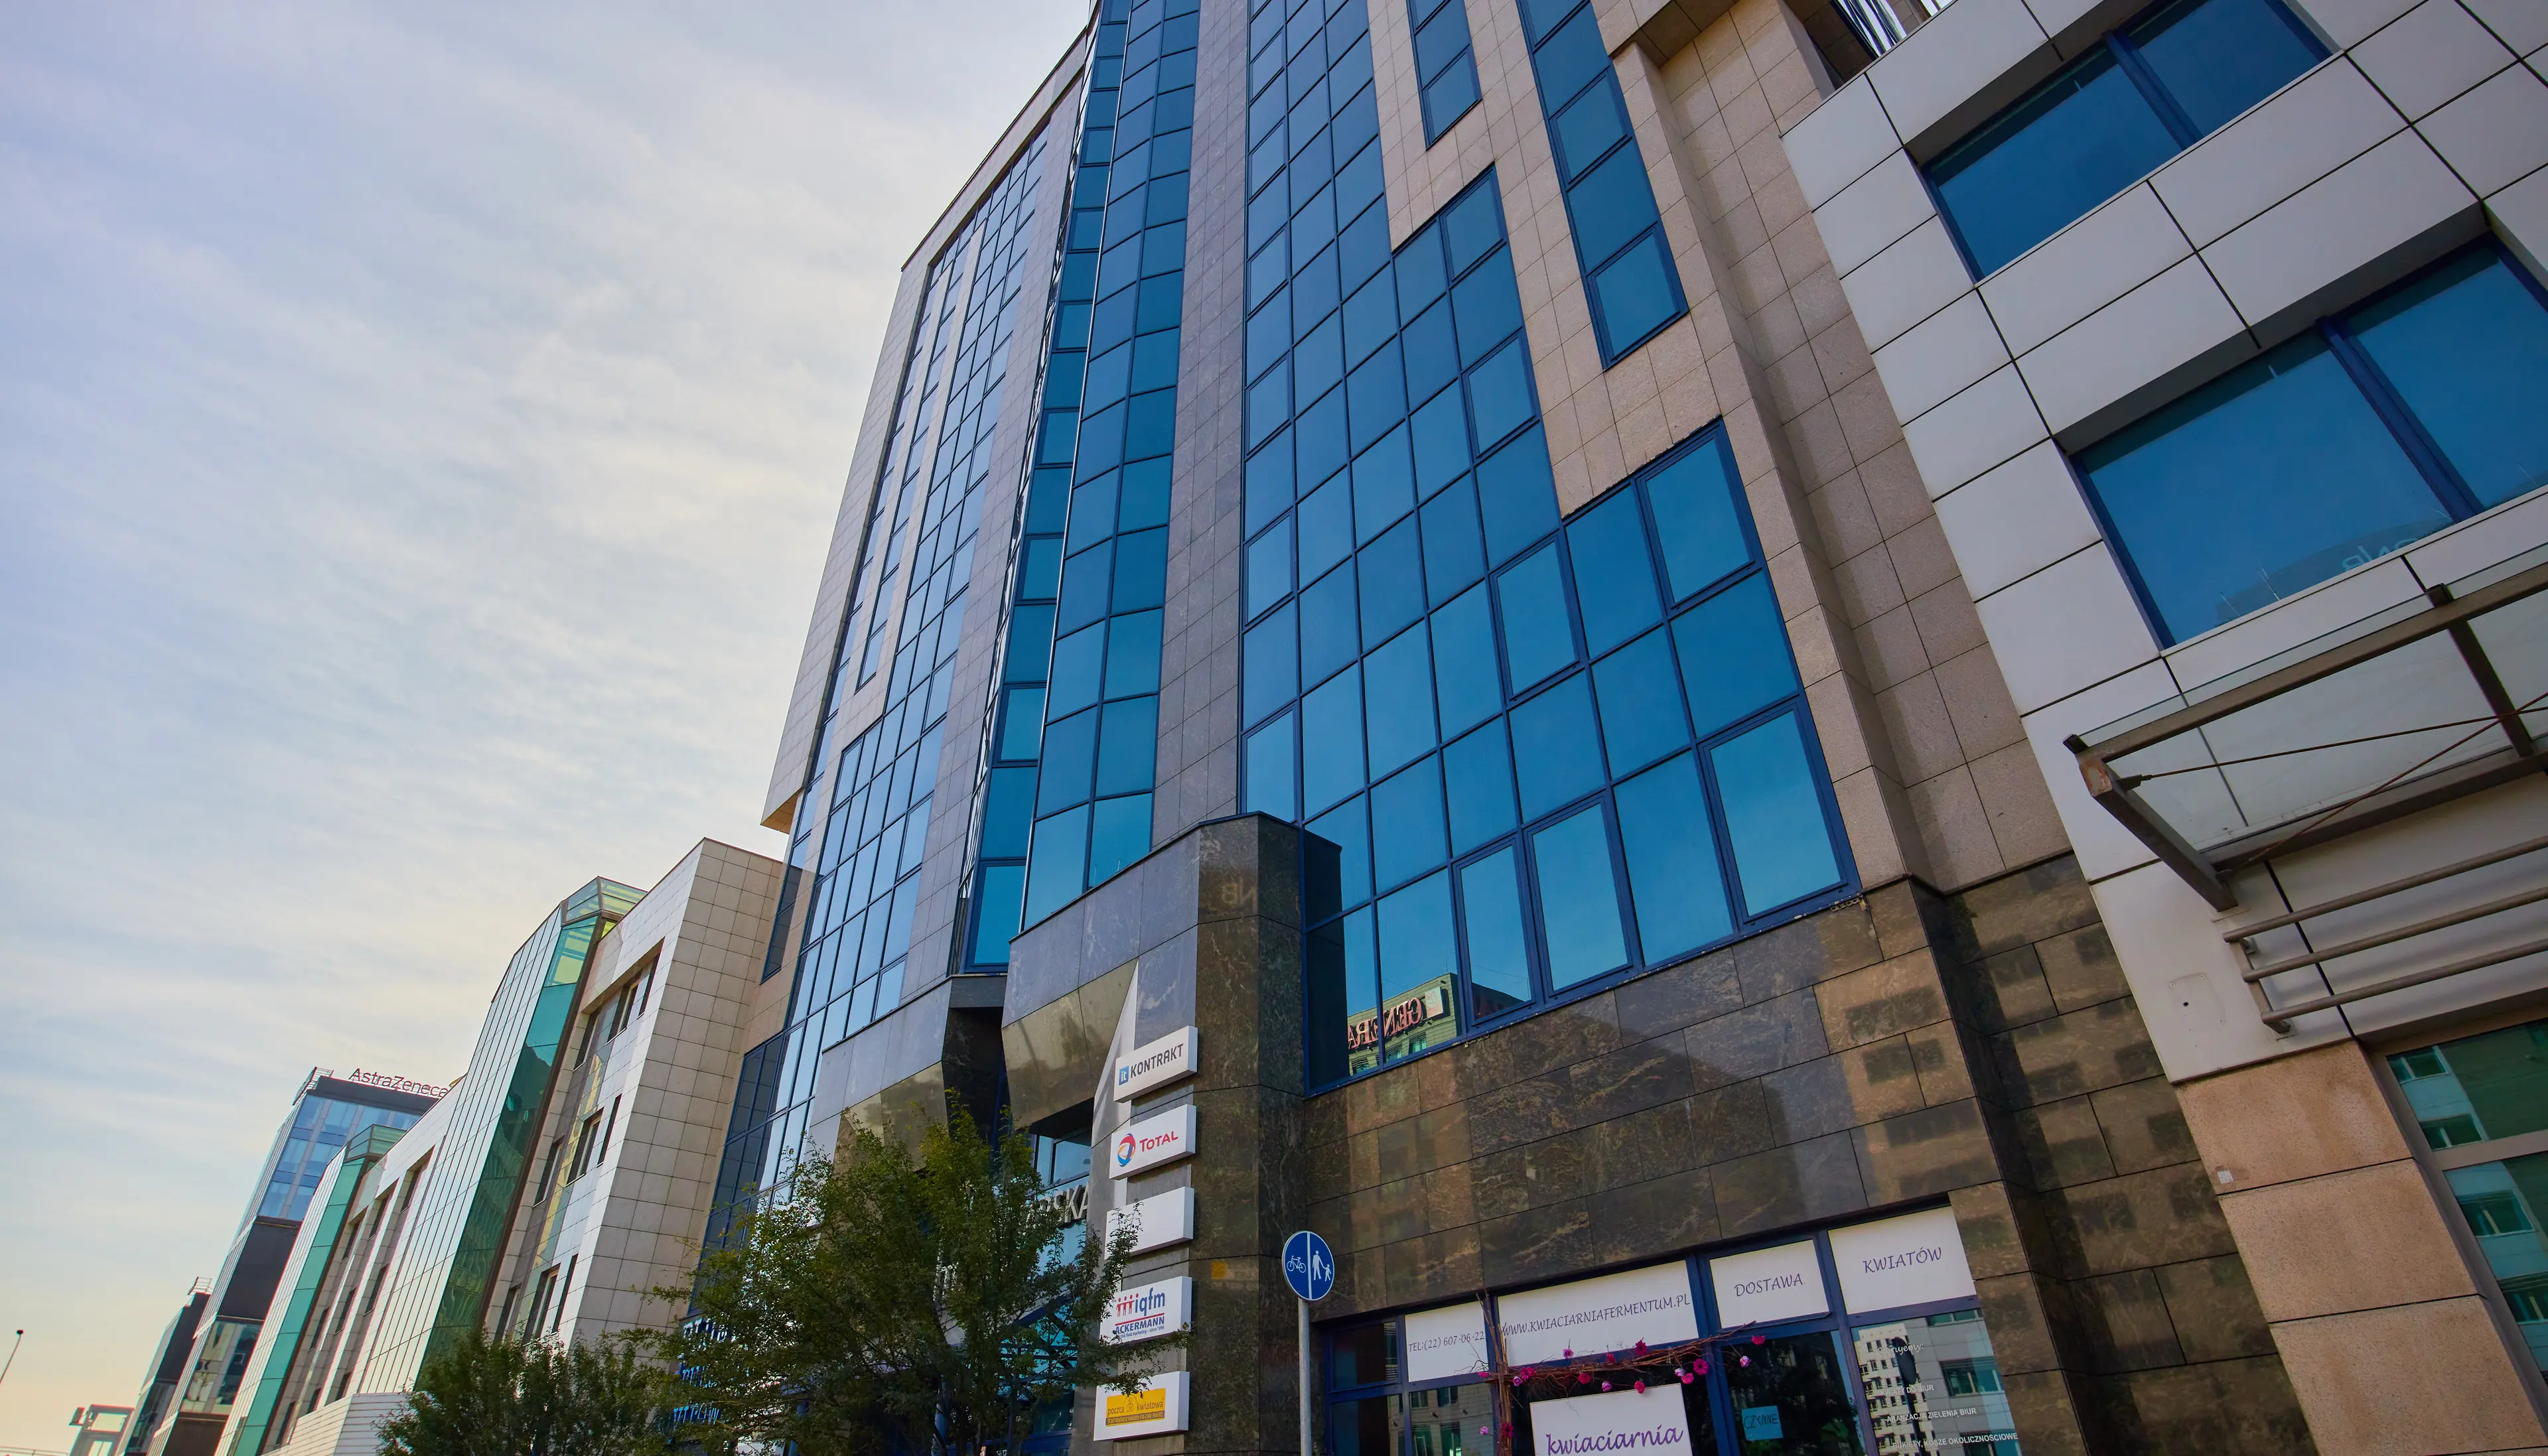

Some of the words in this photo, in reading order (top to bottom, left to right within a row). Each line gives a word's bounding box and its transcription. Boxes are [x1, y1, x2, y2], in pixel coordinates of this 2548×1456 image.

[1131, 1043, 1183, 1078] KONTRAKT
[348, 1068, 449, 1098] AstraZeneca
[1862, 1246, 1942, 1273] KWIATÓW
[1734, 1273, 1803, 1297] DOSTAWA
[1115, 1316, 1165, 1335] ACKERMANN
[1502, 1293, 1691, 1337] WWW.KWIACIARNIAFERMENTUM.PL
[1107, 1406, 1125, 1417] poczta
[1136, 1401, 1163, 1411] kwiatowa
[1744, 1413, 1779, 1429] CZYNNE
[1545, 1423, 1684, 1456] kwiaciarnia
[1924, 1438, 1947, 1447] KOSZE
[1948, 1432, 2018, 1445] OKOLICZNOŚCIOWE
